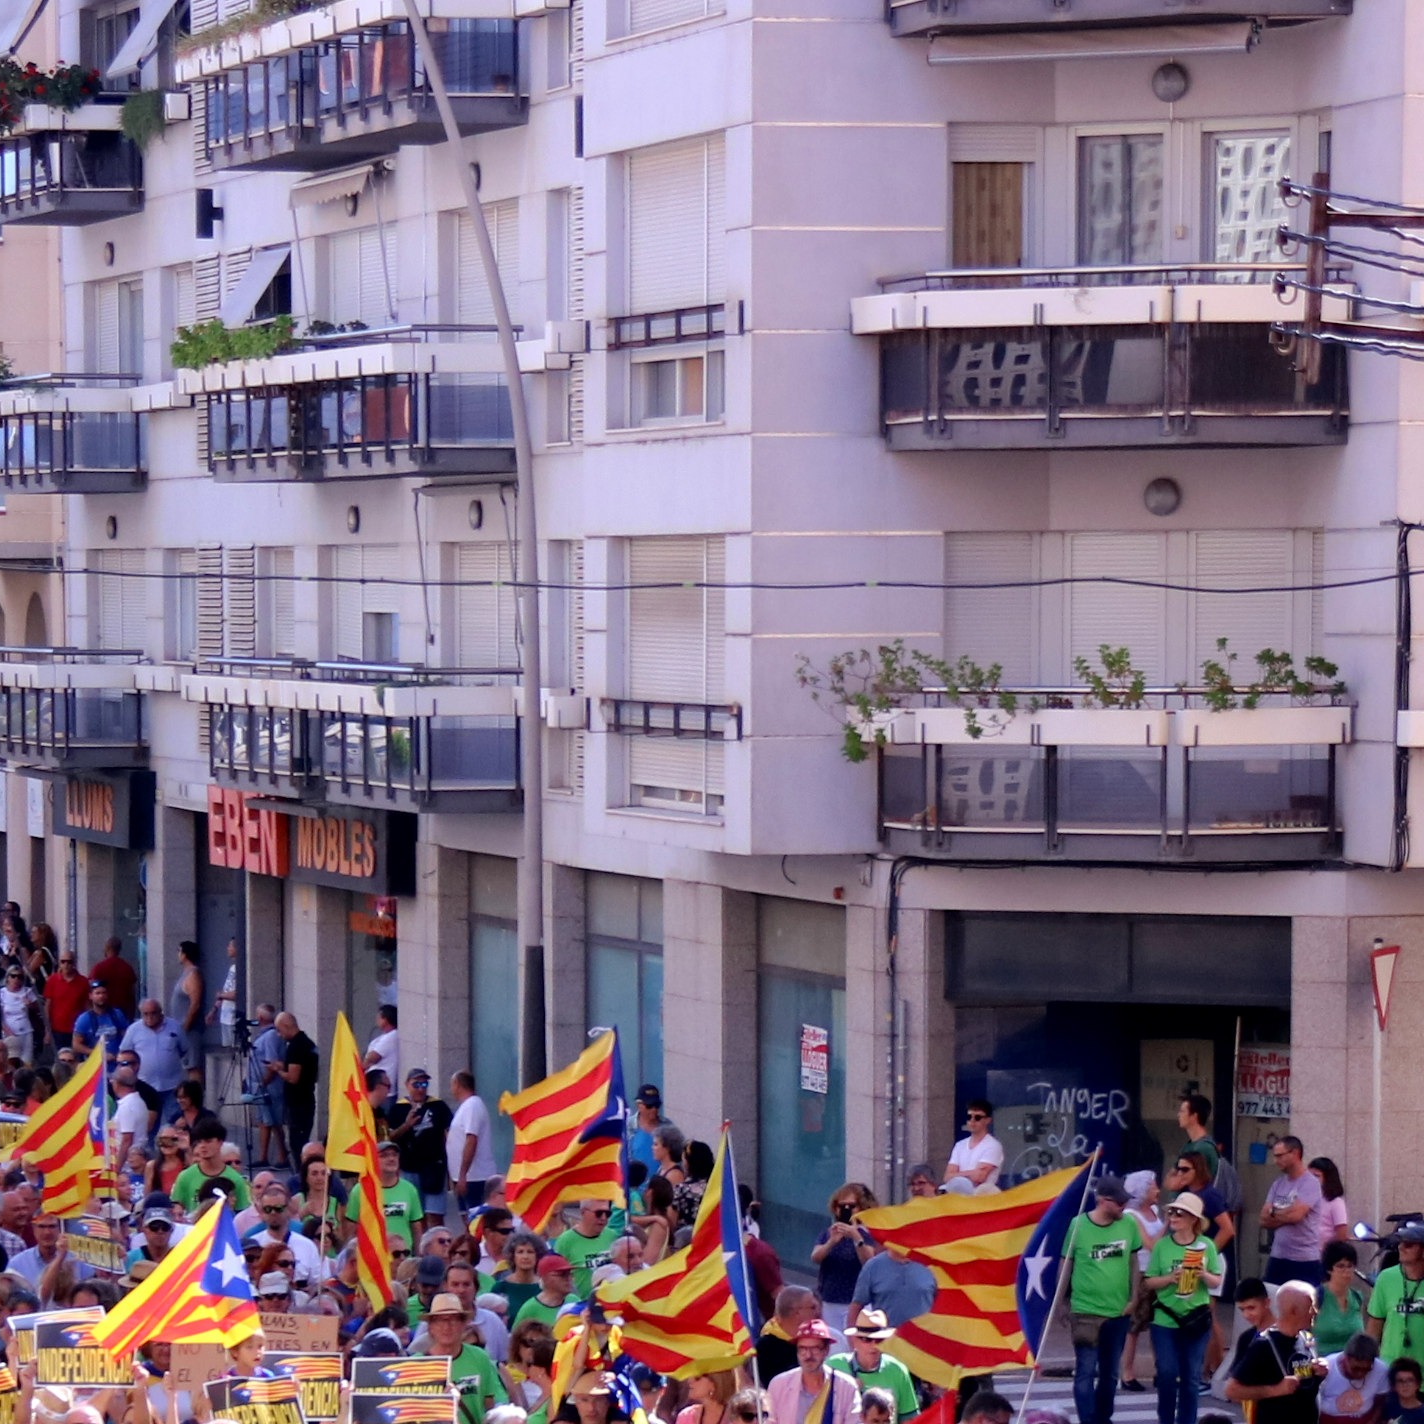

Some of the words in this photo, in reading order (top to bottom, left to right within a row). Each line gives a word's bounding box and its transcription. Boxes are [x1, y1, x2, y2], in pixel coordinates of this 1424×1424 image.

[65, 781, 115, 833] LLUMS
[207, 784, 281, 878] EBEN
[296, 815, 376, 878] MOBLES
[1237, 1073, 1290, 1095] LLOGU
[1237, 1102, 1258, 1115] 977
[1262, 1102, 1282, 1116] 443
